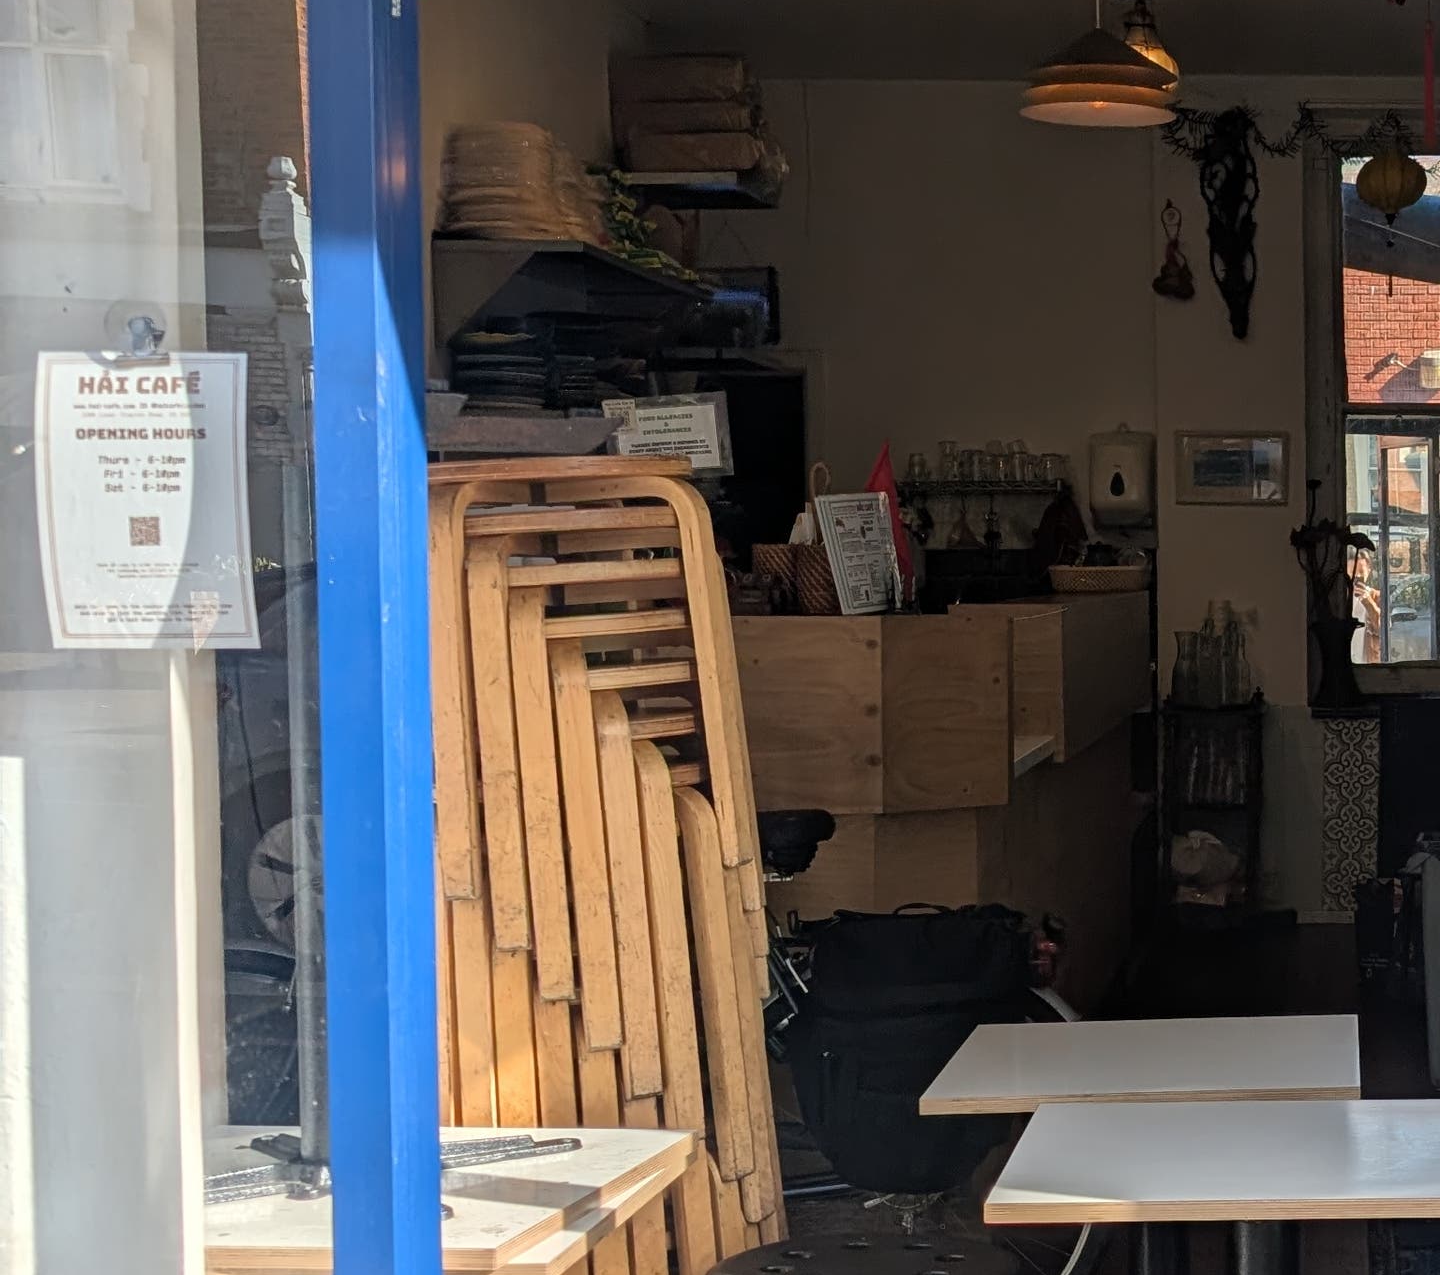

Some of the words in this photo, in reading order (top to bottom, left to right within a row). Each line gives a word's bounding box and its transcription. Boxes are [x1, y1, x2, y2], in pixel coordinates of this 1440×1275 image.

[136, 371, 201, 395] CAFÉ
[75, 428, 148, 440] OPENING
[152, 428, 207, 440] HOURS
[98, 456, 130, 465] Thurs
[104, 470, 124, 478] Fri
[104, 484, 124, 493] Sat
